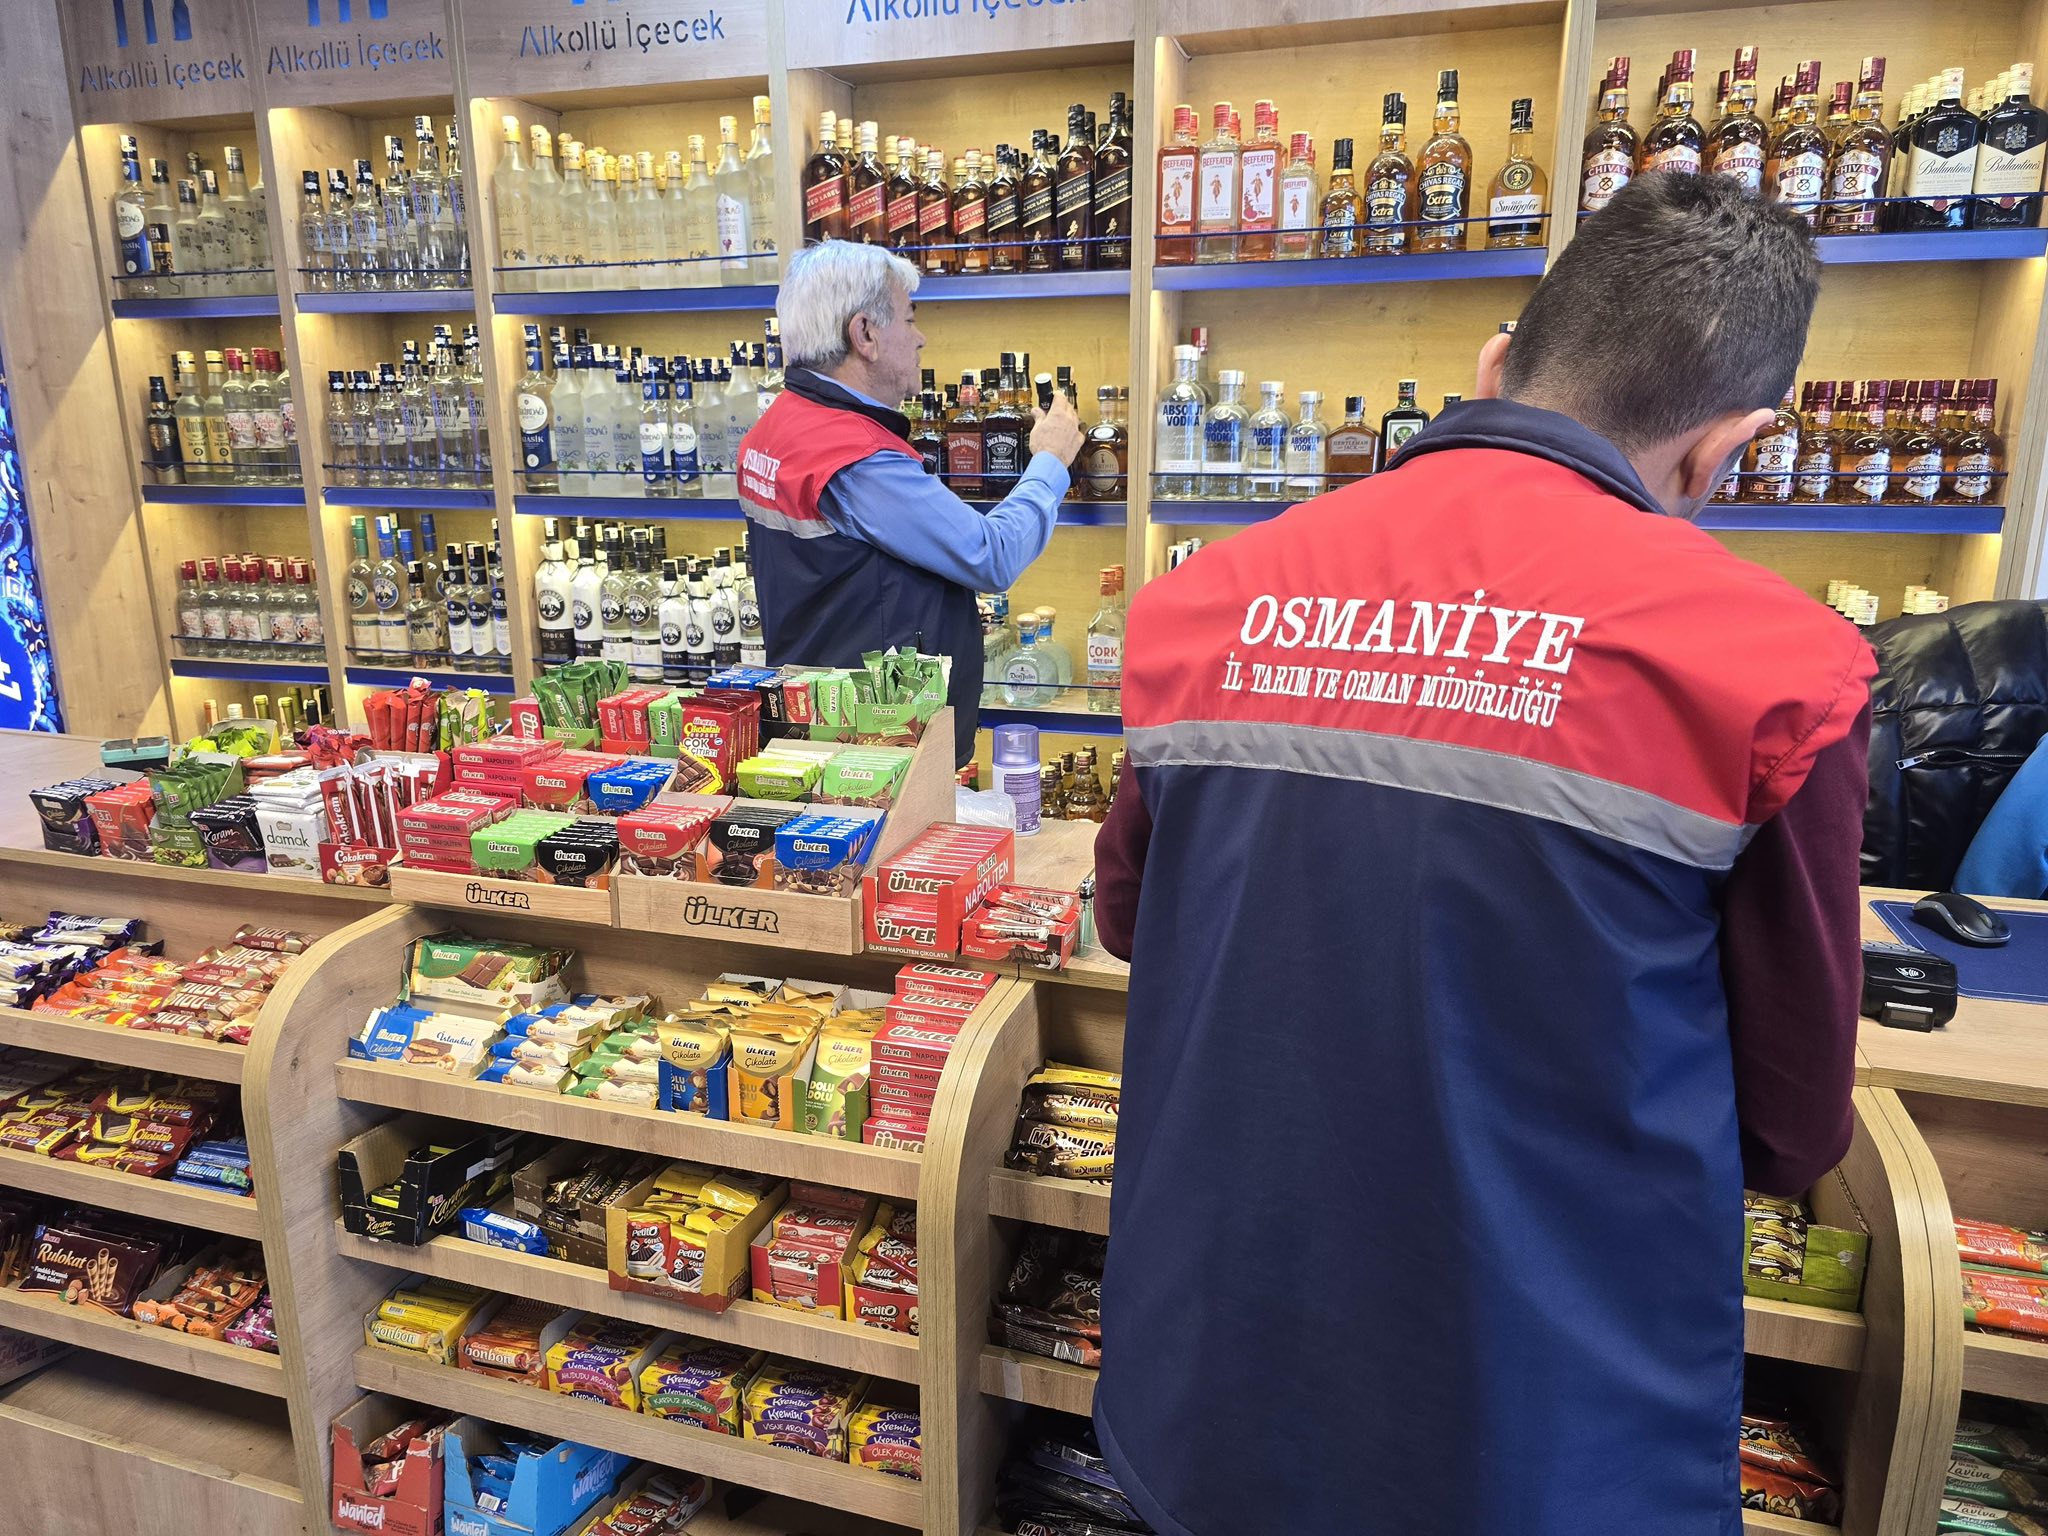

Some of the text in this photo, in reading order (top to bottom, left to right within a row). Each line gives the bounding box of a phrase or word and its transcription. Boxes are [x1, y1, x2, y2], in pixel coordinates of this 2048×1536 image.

[520, 11, 725, 58] Alkollü İçecek
[267, 32, 445, 75] Alkollü İçecek
[80, 53, 247, 93] Alkollü İçecek
[1164, 159, 1193, 169] BEEFEATER
[1203, 156, 1232, 167] BEEFEATER
[1244, 154, 1273, 167] BEEFEATER
[1722, 158, 1761, 170] CHIVAS
[1588, 167, 1627, 177] CHIVAS
[1786, 167, 1822, 177] CHIVAS
[1835, 165, 1872, 175] CHIVAS
[1073, 183, 1090, 193] LABEL
[1111, 180, 1128, 192] LABEL
[1419, 177, 1464, 190] CHIVAS REGAL
[820, 189, 840, 202] LABEL
[1427, 192, 1453, 205] Extra
[862, 196, 880, 208] LABEL
[1495, 198, 1539, 213] Smuggler
[1371, 206, 1393, 217] Extra
[1162, 404, 1204, 417] ABSOLUT
[1166, 415, 1200, 427] VODKA
[1206, 432, 1236, 443] VODKA
[1252, 427, 1287, 438] ABSOLUT
[986, 434, 1018, 447] JACK DANIEL'S
[1256, 436, 1285, 446] VODKA
[1290, 436, 1321, 446] ABSOLUT
[1293, 444, 1318, 452] VODKA
[1239, 588, 1585, 675] OSMANİYE
[1088, 646, 1118, 658] CORK
[1222, 652, 1563, 728] İL TARIM VE ORMAN MÜDÜRLÜĞÜ
[768, 693, 778, 718] ÜLKER
[829, 686, 837, 713] ÜLKER
[871, 707, 897, 715] ÜLKER
[659, 711, 667, 737] ÜLKER
[693, 717, 717, 726] ÜLKER
[683, 723, 720, 735] Çikolatalı
[684, 738, 709, 750] ÇOK
[460, 754, 483, 763] ÜLKER
[690, 747, 718, 758] ÇITIRTI
[462, 770, 485, 779] ÜLKER
[840, 768, 874, 780] ÜLKER
[536, 776, 566, 788] ÜLKER
[601, 783, 634, 796] ÜLKER
[404, 819, 428, 829] ÜLKER
[204, 828, 240, 846] Karam
[267, 825, 310, 848] damak
[635, 829, 666, 841] ÜLKER
[728, 824, 760, 838] ÜLKER
[405, 834, 429, 845] ÜLKER
[488, 841, 519, 854] ÜLKER
[793, 839, 830, 854] ÜLKER
[335, 850, 377, 867] Çokokrem
[410, 851, 434, 861] ÜLKER
[555, 850, 585, 862] ÜLKER
[556, 863, 586, 874] Çikolata
[976, 853, 996, 880] ÜLKER
[965, 859, 1009, 912] NAPOLİTEN
[465, 882, 530, 909] ÜLKER
[684, 896, 780, 933] ÜLKER
[432, 949, 460, 961] ÜLKER
[868, 944, 949, 959] ÜLKER NAPOLİTEN ÇİKOLATA
[911, 961, 984, 982] ÜLKER
[905, 979, 935, 993] ÜLKER
[895, 1011, 926, 1025] ÜLKER
[377, 1029, 407, 1041] ÜLKER
[672, 1038, 700, 1050] ÜLKER
[832, 1042, 863, 1054] ÜLKER
[671, 1050, 701, 1061] Çikolata
[746, 1046, 776, 1056] ÜLKER
[879, 1045, 911, 1059] ÜLKER
[745, 1057, 777, 1069] Çikolata
[828, 1054, 863, 1065] Çikolata
[878, 1065, 911, 1080] ÜLKER
[810, 1080, 835, 1092] DOLU
[878, 1083, 911, 1098] ÜLKER
[807, 1090, 833, 1102] DOLU
[880, 1103, 912, 1118] ÜLKER
[1075, 1166, 1102, 1175] MAXIMUS
[37, 1243, 87, 1269] Rulokat
[372, 1322, 417, 1344] bonbon
[464, 1346, 512, 1362] bonbon
[572, 1350, 612, 1363] Kremini
[666, 1374, 704, 1387] Kremini
[780, 1386, 818, 1397] Kremini
[768, 1408, 803, 1421] Kremini
[785, 1425, 817, 1439] AROMALI
[877, 1421, 916, 1434] Kremini
[1948, 1461, 1992, 1479] Laviva
[1948, 1501, 1998, 1518] Laviva
